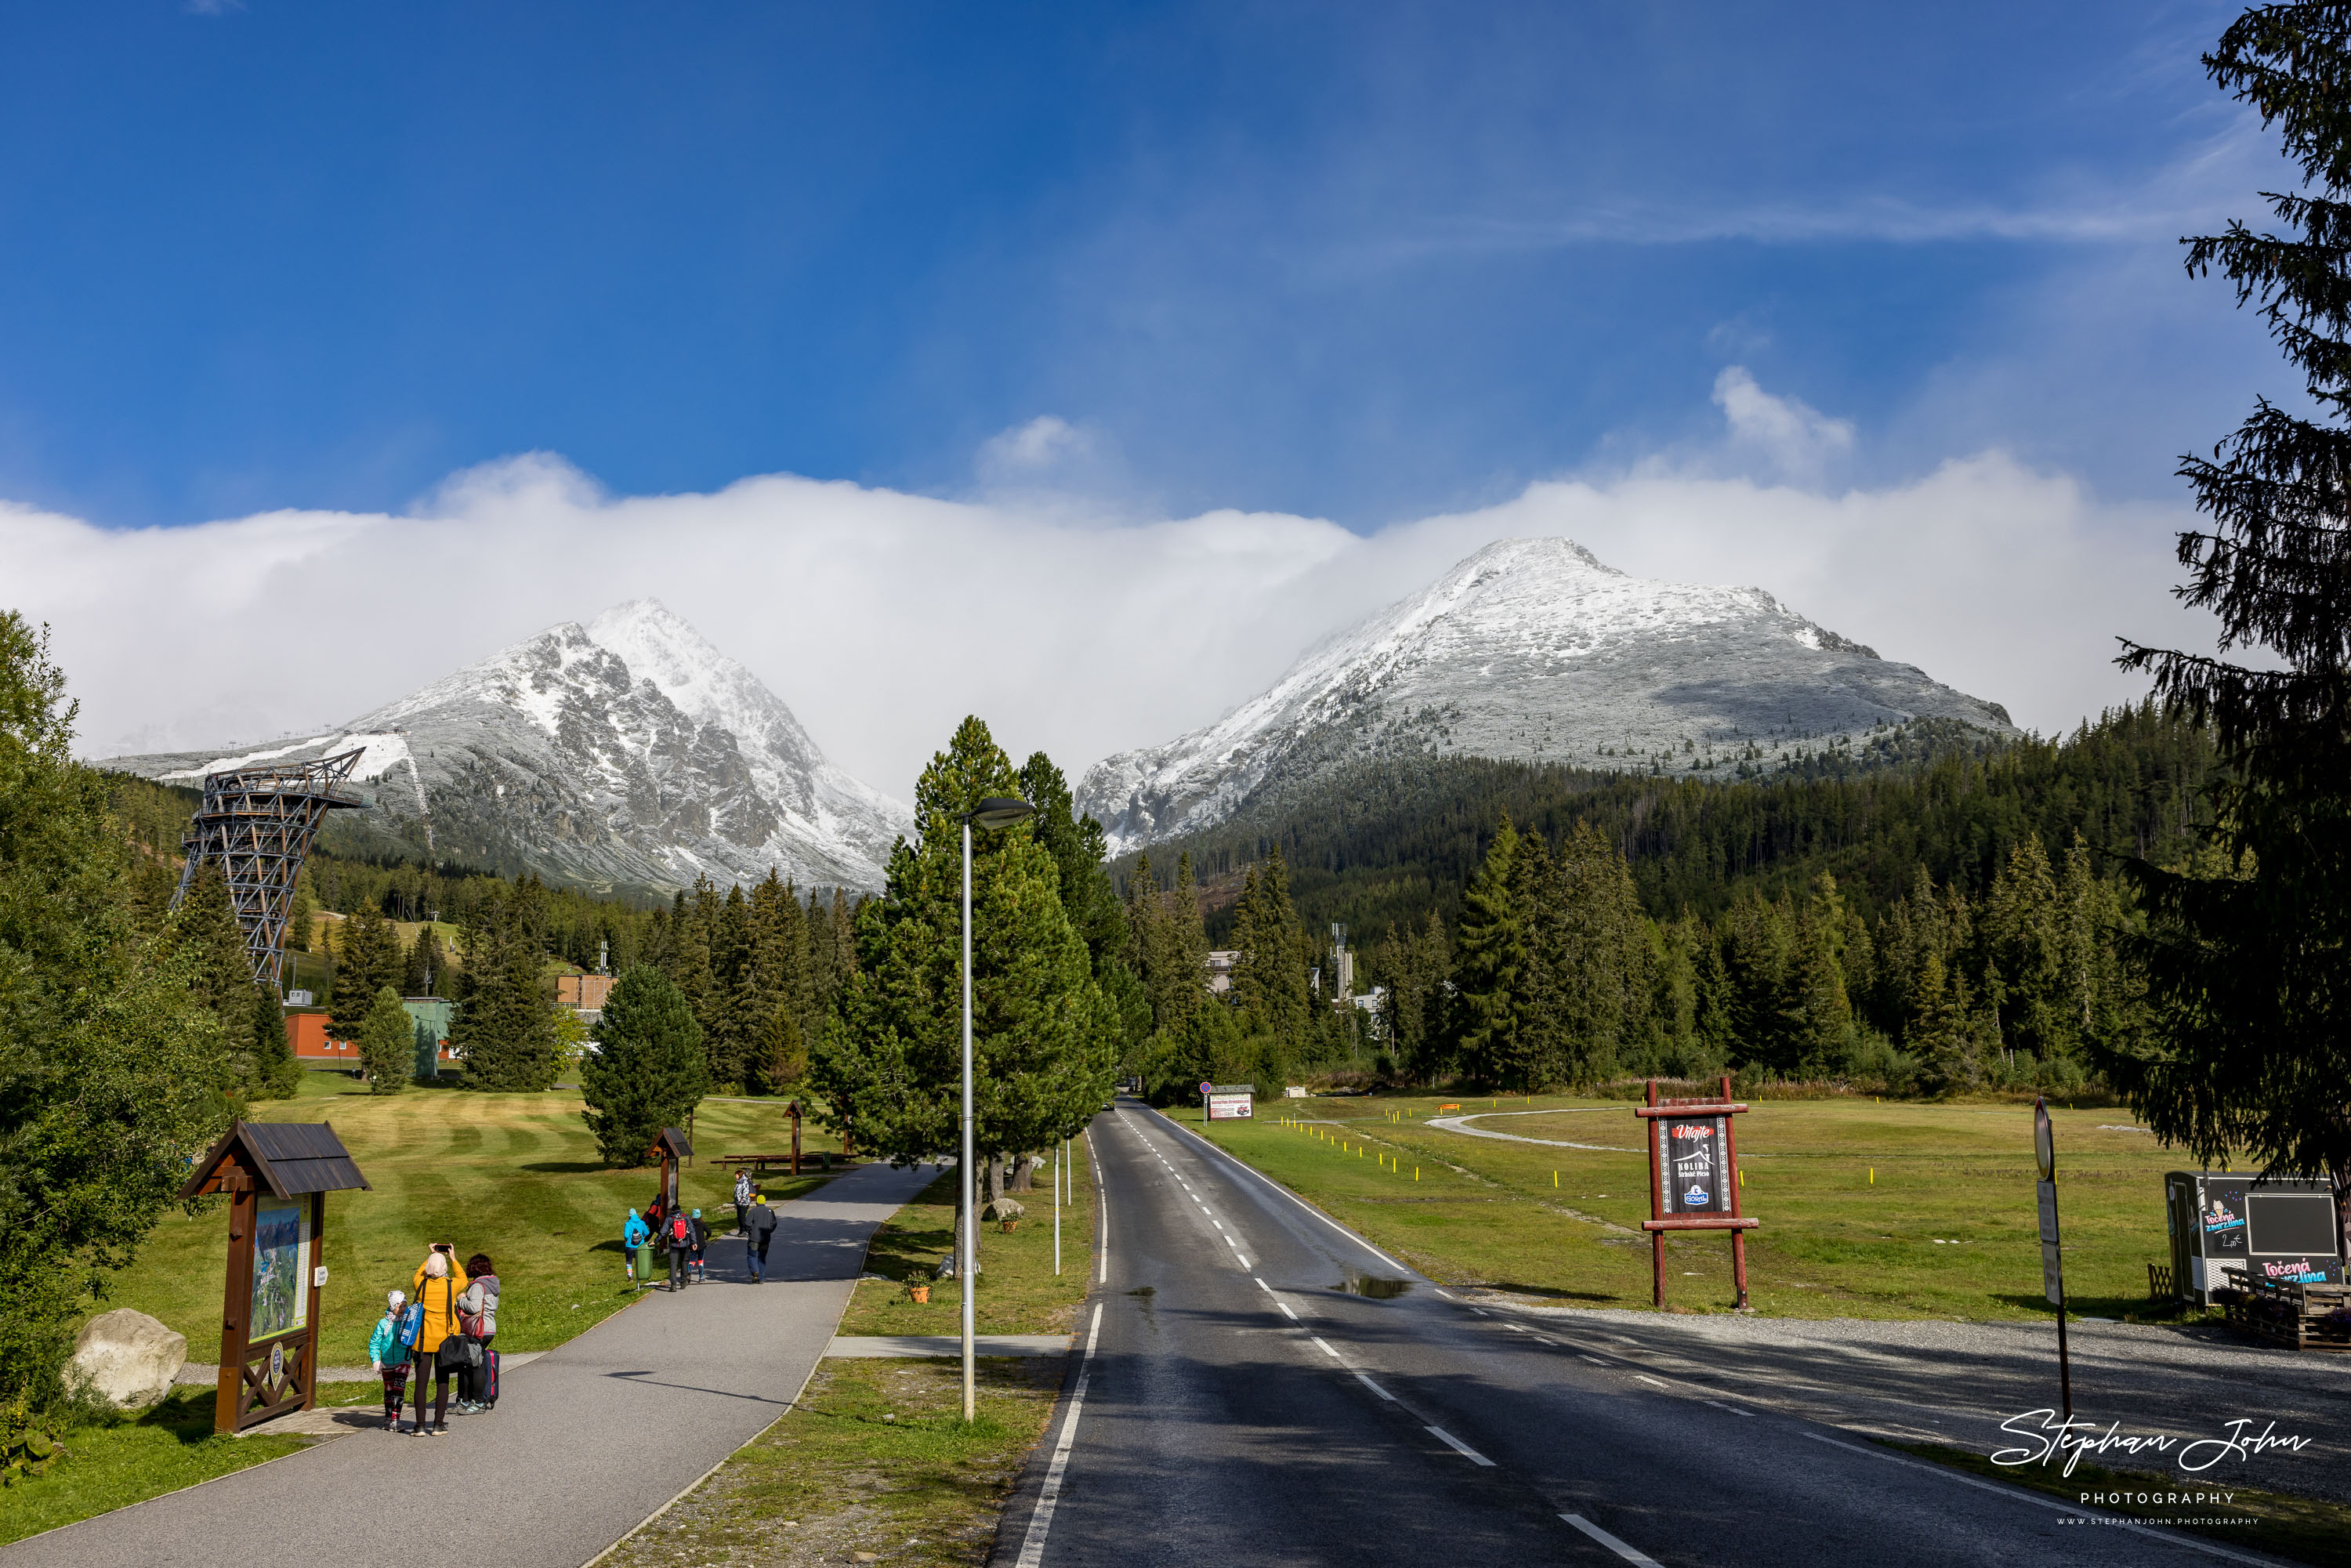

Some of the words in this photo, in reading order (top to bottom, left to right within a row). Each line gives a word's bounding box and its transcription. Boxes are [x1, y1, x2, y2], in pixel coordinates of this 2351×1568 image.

[1676, 1124, 1710, 1143] Vitajte
[1678, 1162, 1709, 1171] KOLIBA
[2205, 1219, 2244, 1232] zmrzlina
[2262, 1258, 2310, 1276] Točená
